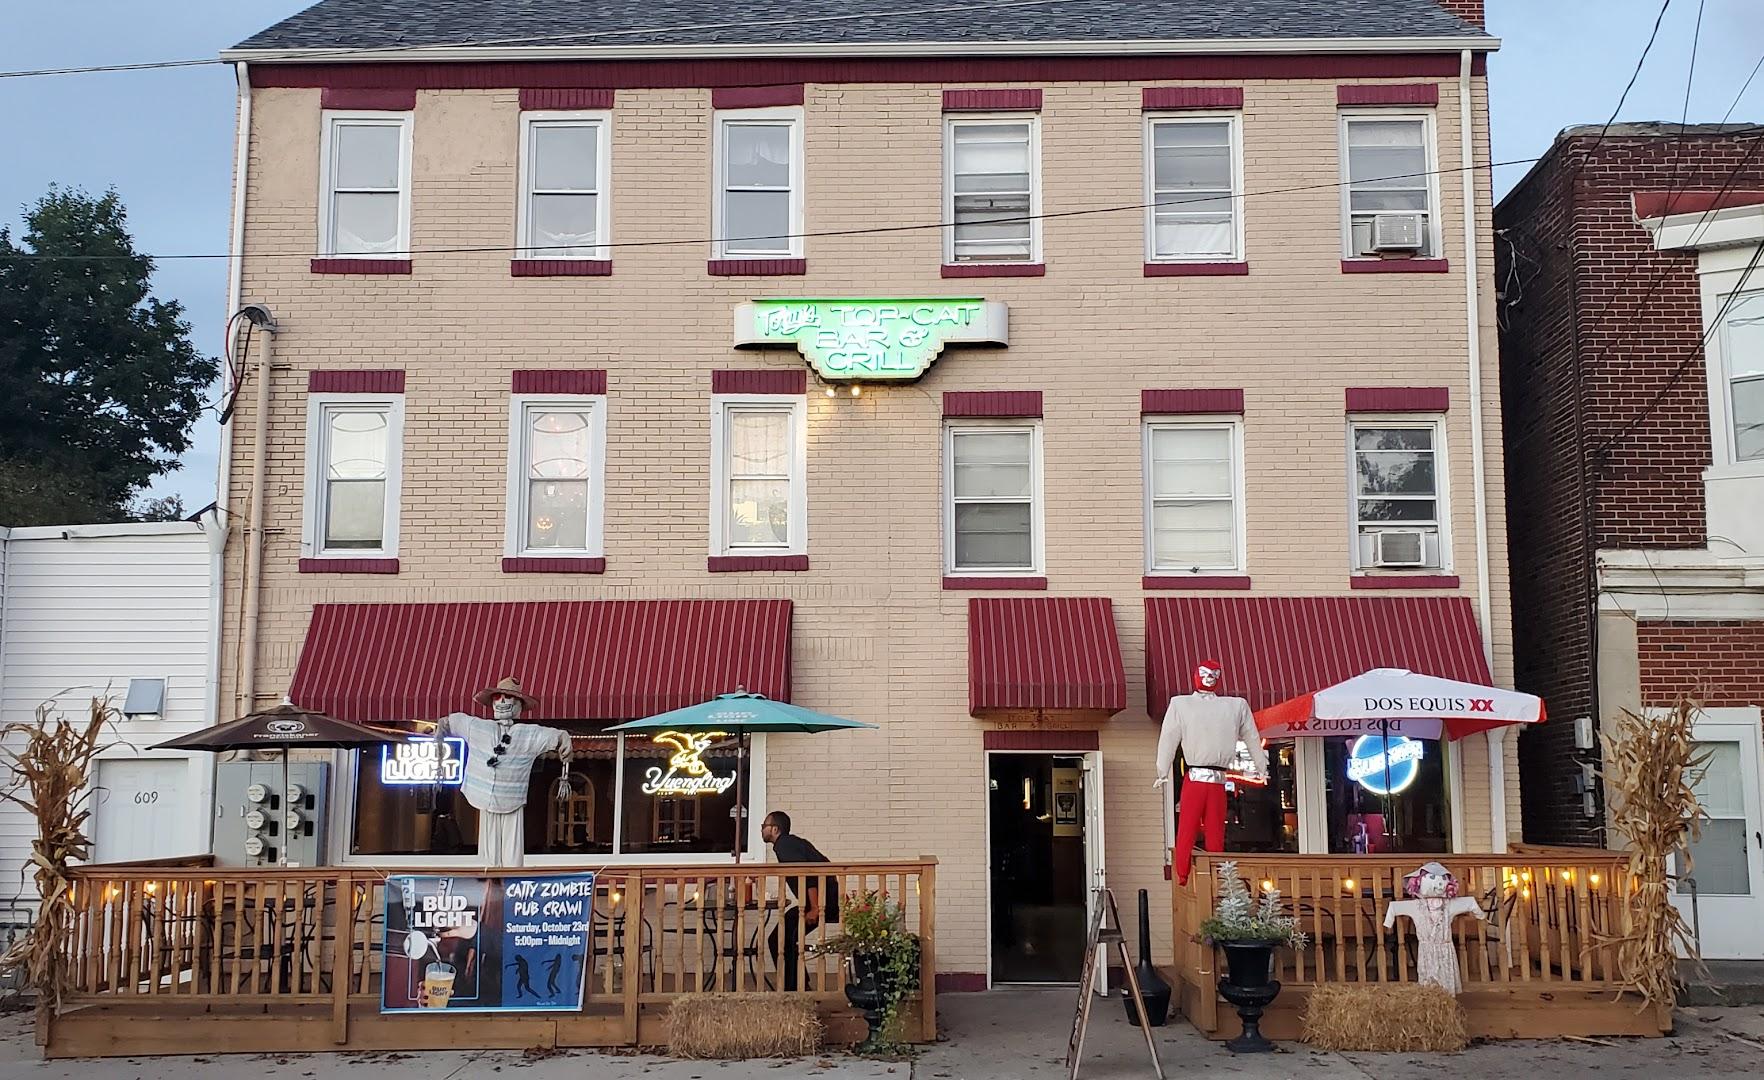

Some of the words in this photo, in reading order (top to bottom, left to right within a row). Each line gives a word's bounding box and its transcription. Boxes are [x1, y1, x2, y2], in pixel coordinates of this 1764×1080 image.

[757, 304, 821, 336] Tony's
[829, 304, 980, 328] TOP-CAT
[815, 330, 891, 349] BAR
[898, 325, 929, 348] &
[1364, 697, 1403, 711] DOS
[1409, 697, 1465, 712] EQUIS
[1468, 699, 1494, 713] XX
[396, 742, 451, 761] BUD
[642, 767, 737, 794] Yuengling
[134, 791, 159, 804] 609
[540, 881, 592, 898] ZOMBIE
[423, 896, 468, 912] BUD
[514, 900, 540, 917] PUB
[414, 911, 476, 928] LIGHT
[506, 922, 542, 935] Saturday,
[542, 921, 571, 933] October
[572, 921, 590, 932] 23rd
[514, 935, 543, 947] 5:00pm
[548, 934, 581, 947] Midnight
